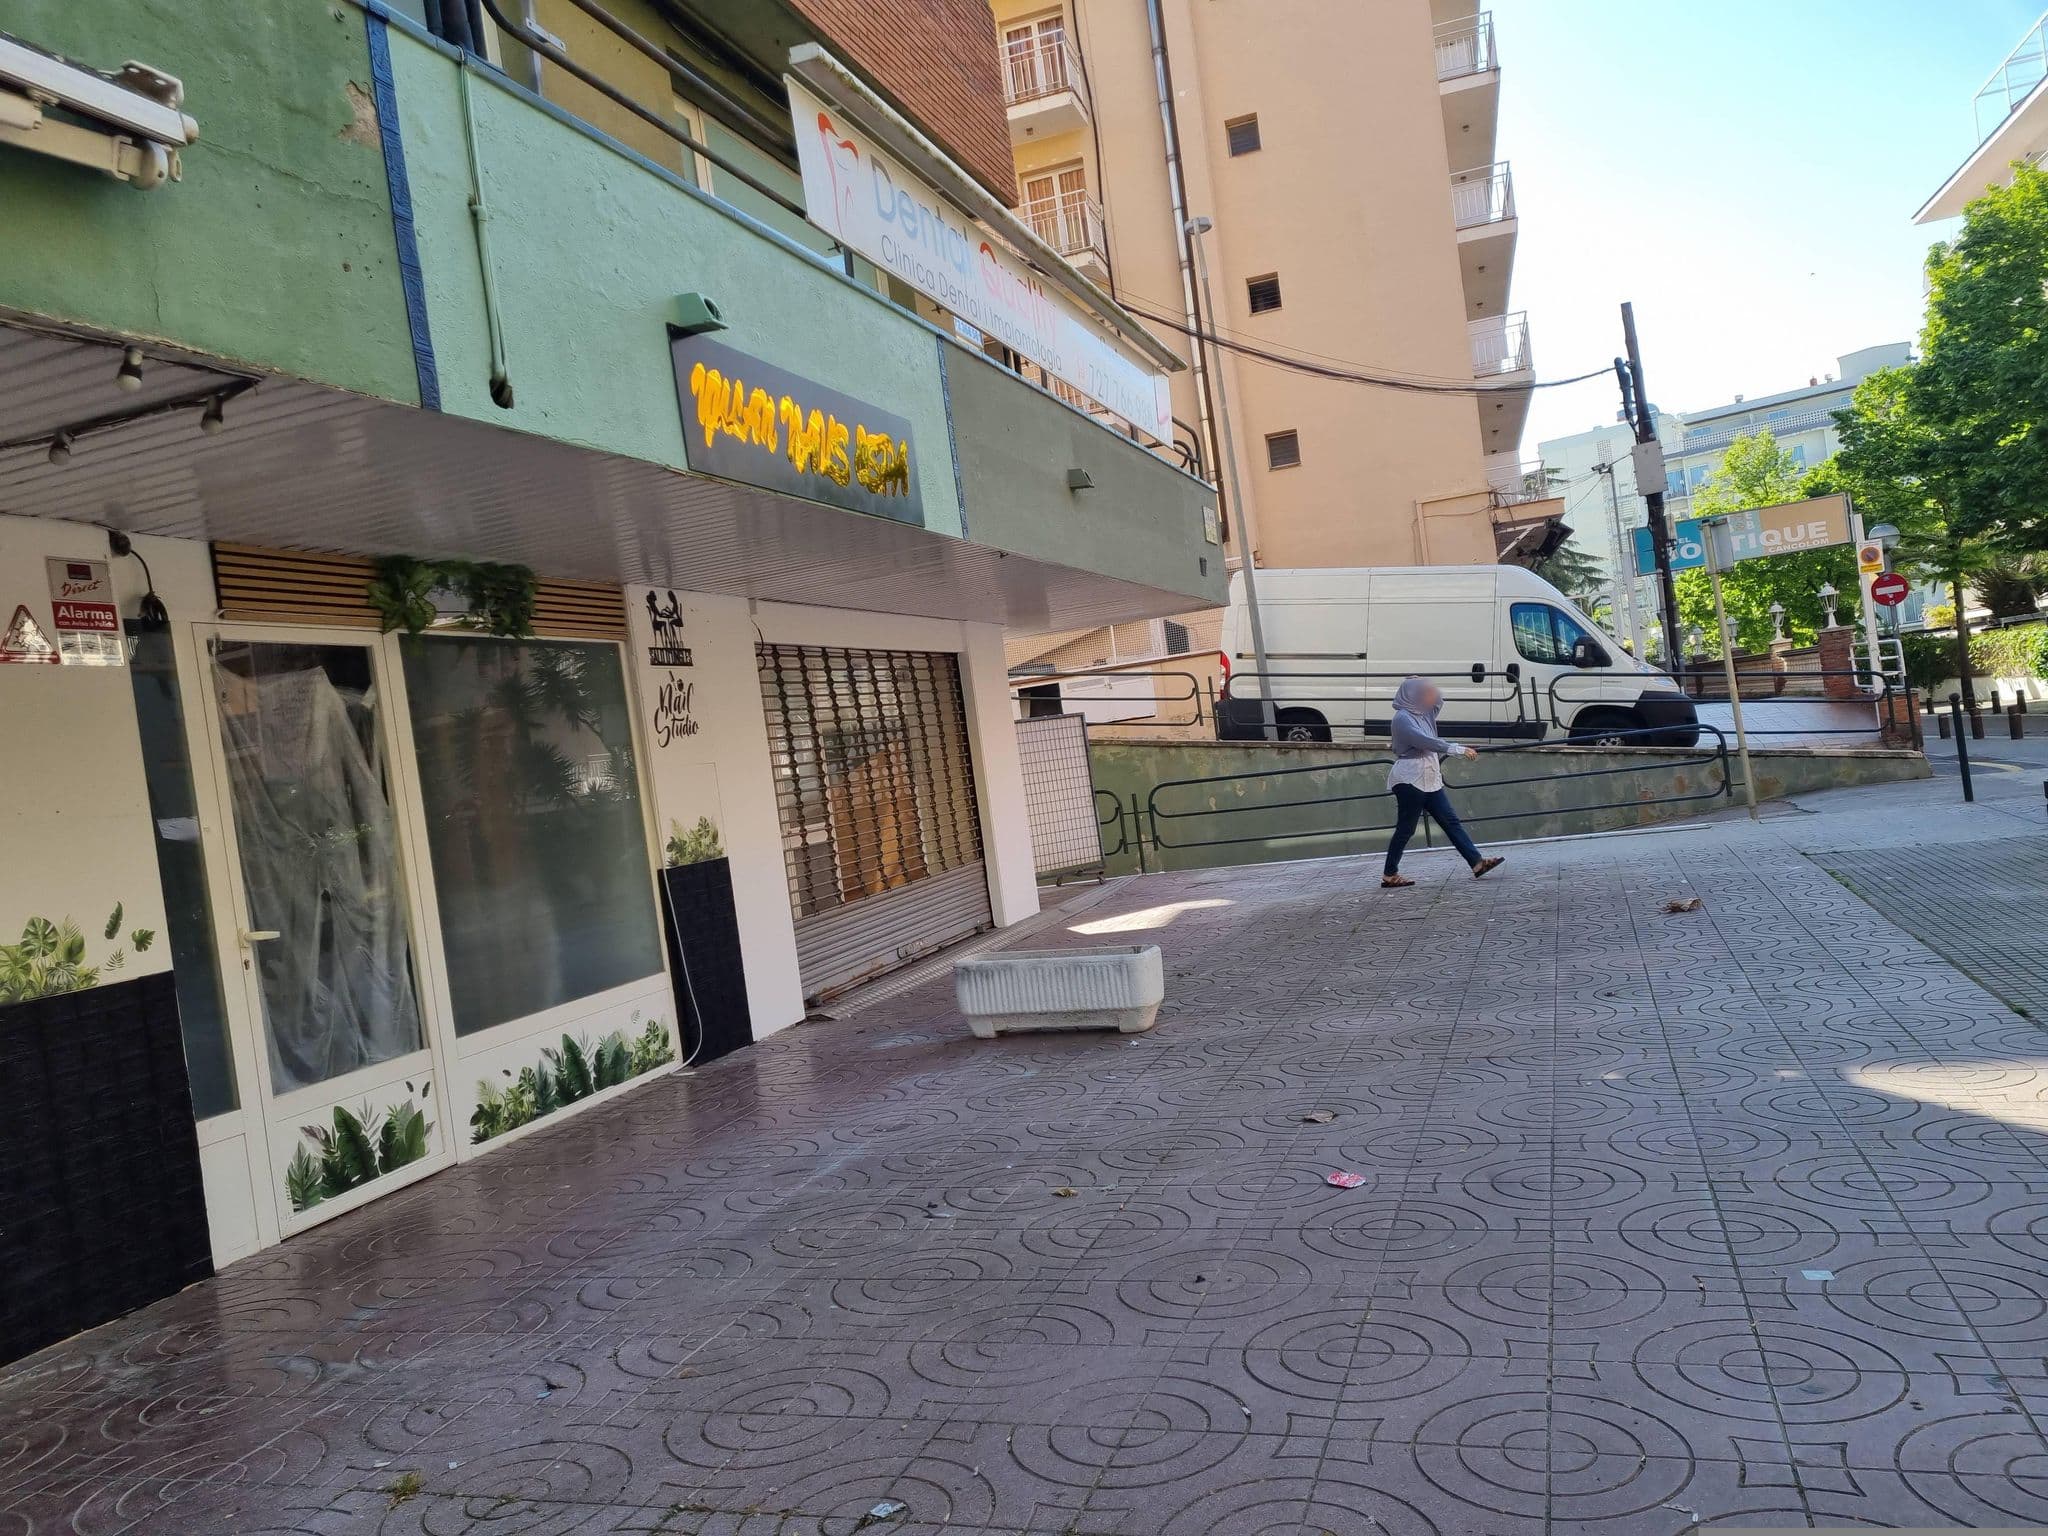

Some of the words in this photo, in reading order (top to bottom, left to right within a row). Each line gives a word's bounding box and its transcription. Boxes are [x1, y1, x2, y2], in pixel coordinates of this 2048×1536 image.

[871, 154, 972, 274] Dental
[938, 272, 979, 319] Dental
[1768, 537, 1829, 553] CANCOLOM
[58, 605, 114, 620] Alarma
[654, 706, 700, 748] Studio
